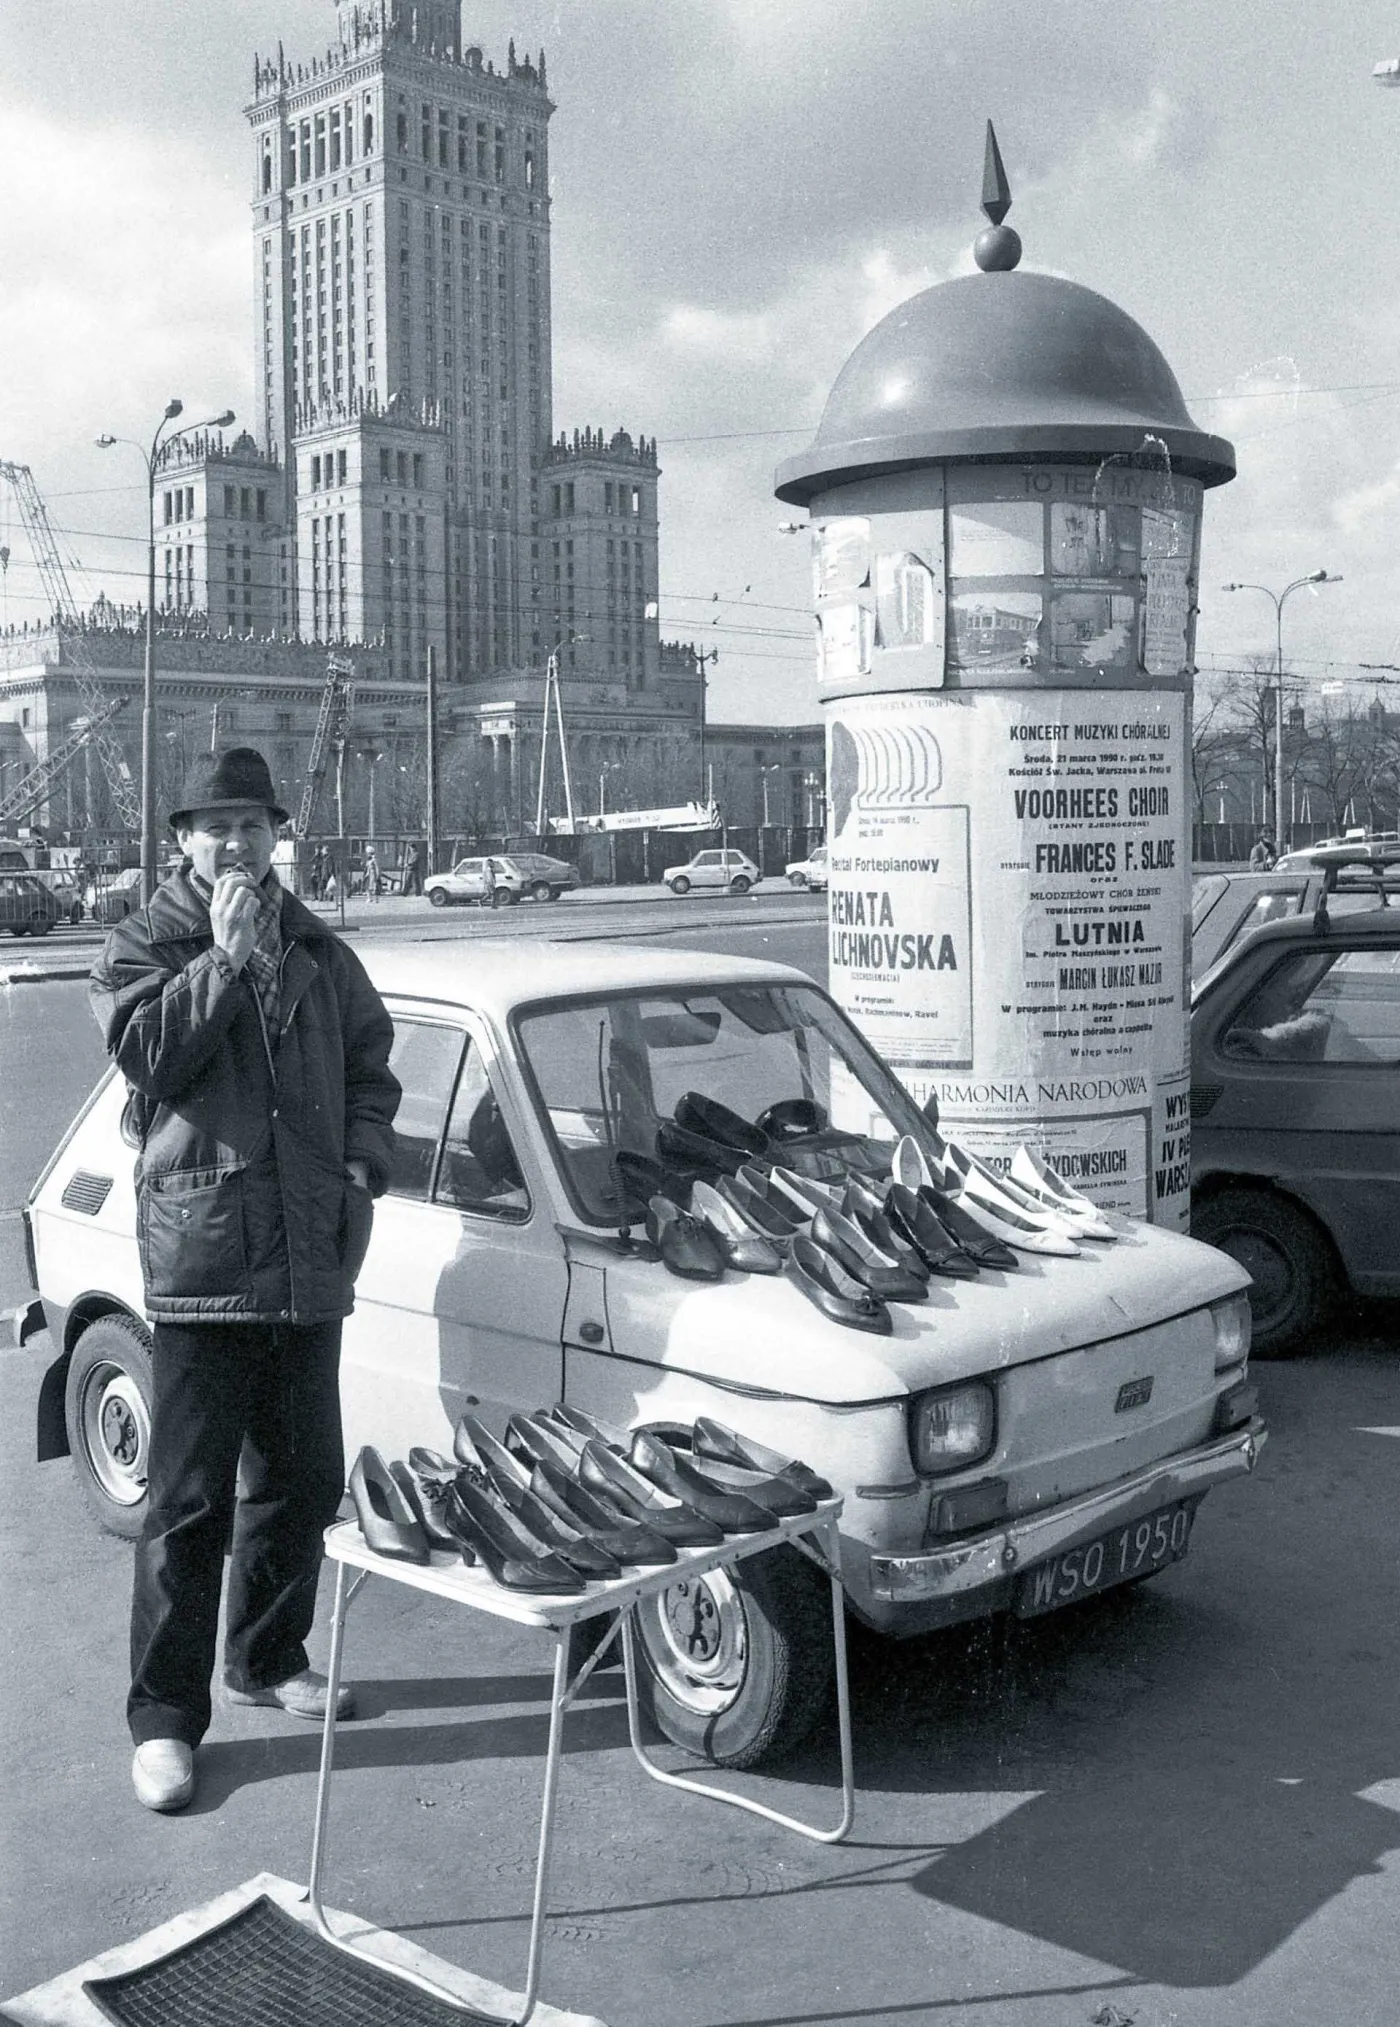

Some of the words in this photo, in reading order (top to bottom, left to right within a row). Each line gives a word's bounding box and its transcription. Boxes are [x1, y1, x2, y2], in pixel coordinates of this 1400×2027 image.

[1010, 724, 1069, 741] KONCERT
[1074, 724, 1118, 740] MUZYKI
[1122, 721, 1171, 740] CHÓRALNEJ
[1056, 754, 1067, 763] 21
[1069, 754, 1097, 763] marca
[1099, 753, 1118, 762] 1990
[1014, 788, 1119, 820] VOORHEES
[1129, 786, 1169, 817] CHOIR
[855, 857, 940, 874] Fortepianowy
[1036, 841, 1116, 873] FRANCES
[1125, 841, 1138, 871] F.
[1141, 839, 1175, 870] SLADE
[1090, 876, 1118, 884] oraz
[1030, 889, 1105, 901] MŁODZIEŻOWY
[1109, 889, 1134, 899] CHÓR
[832, 890, 895, 928] RENATA
[1045, 906, 1104, 915] TOWARZYSTWA
[1055, 920, 1145, 946] LUTNIA
[833, 931, 957, 971] LICHNOVSKA
[1060, 967, 1097, 991] MARCIN
[1102, 965, 1136, 989] ŁUKASZ
[915, 1010, 939, 1019] Ravel
[1001, 1004, 1011, 1013] W
[1016, 1005, 1067, 1014] programie:
[1092, 1001, 1118, 1012] Haydn
[1043, 1029, 1079, 1039] muzyka
[1038, 1075, 1148, 1102] NARODOWA
[1162, 1139, 1176, 1164] IV
[1033, 1541, 1105, 1607] WSO
[1119, 1509, 1189, 1574] 1950
